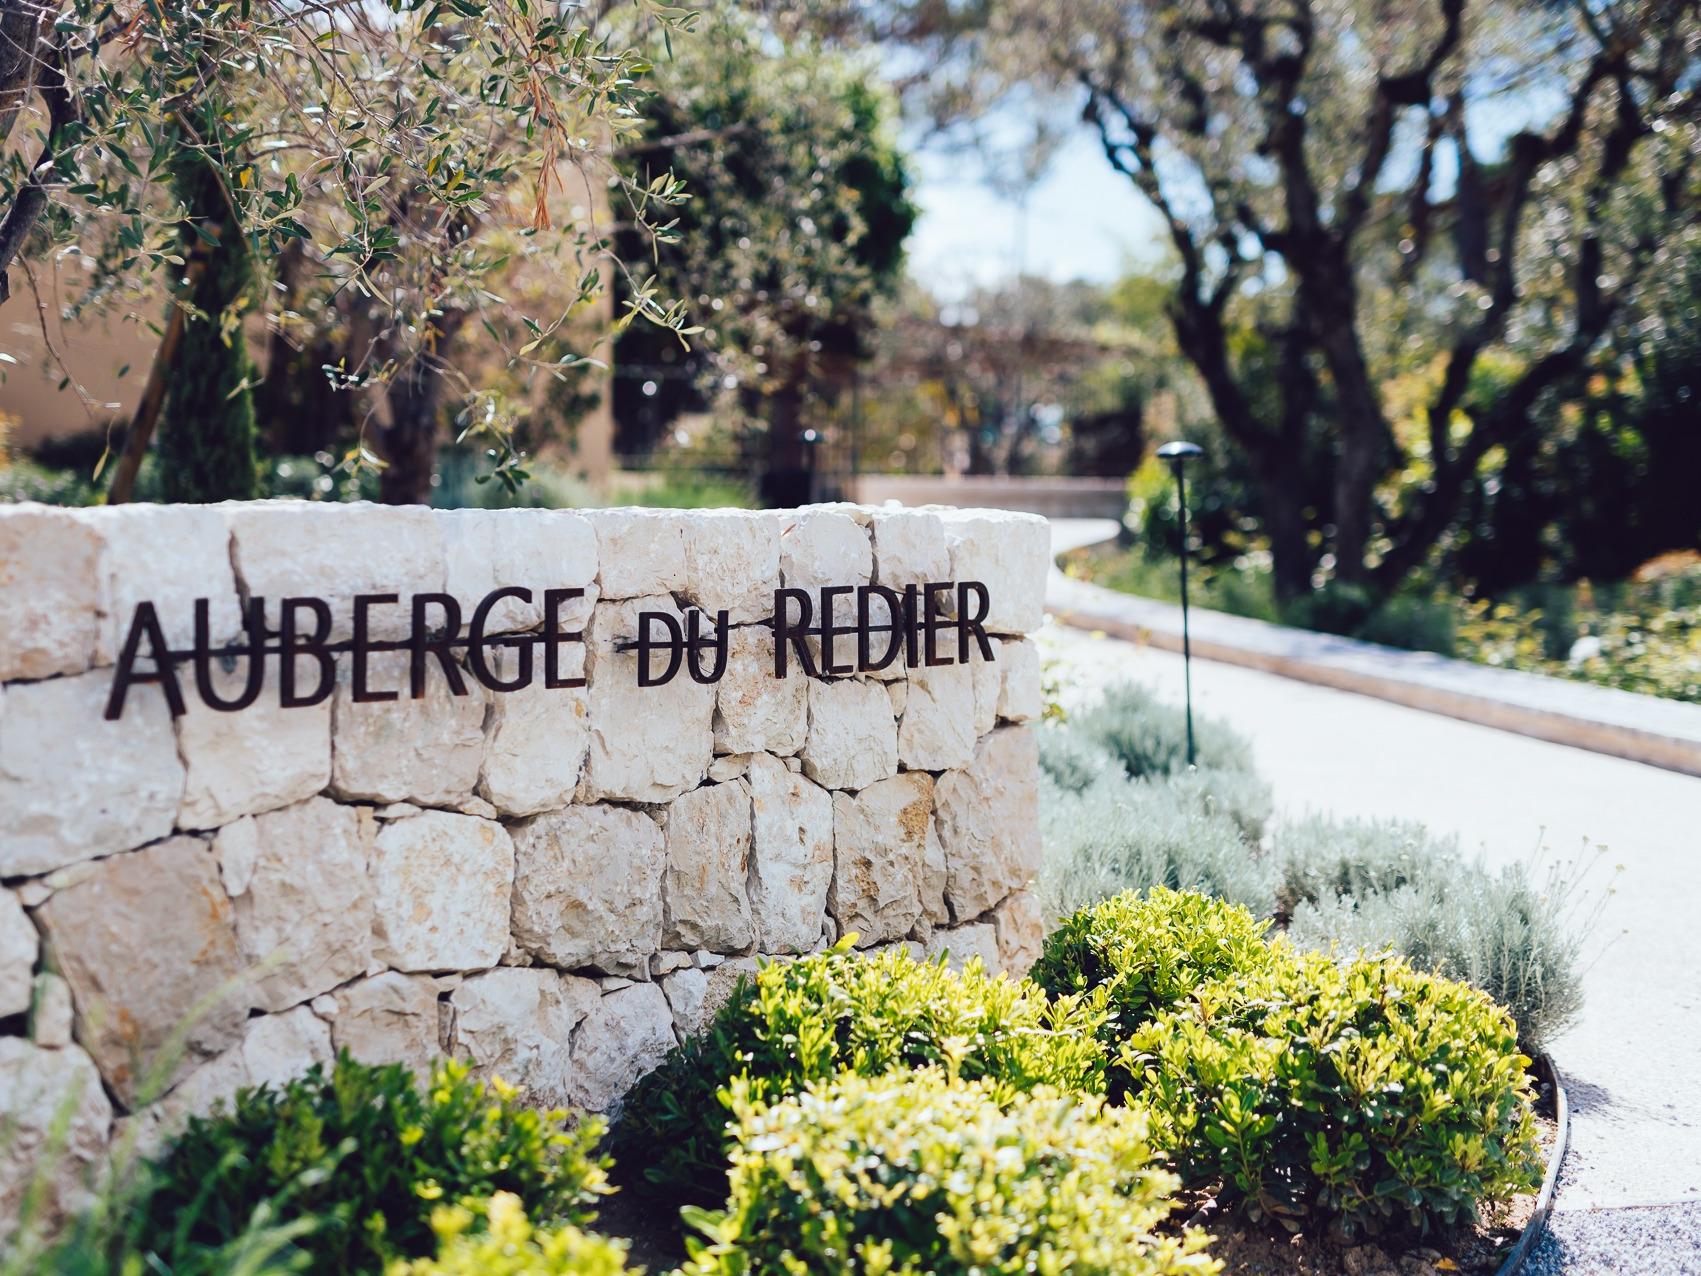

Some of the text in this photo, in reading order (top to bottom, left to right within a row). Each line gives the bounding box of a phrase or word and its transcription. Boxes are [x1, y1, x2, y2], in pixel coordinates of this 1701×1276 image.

[104, 581, 995, 721] AUBERGE DU REDIER
